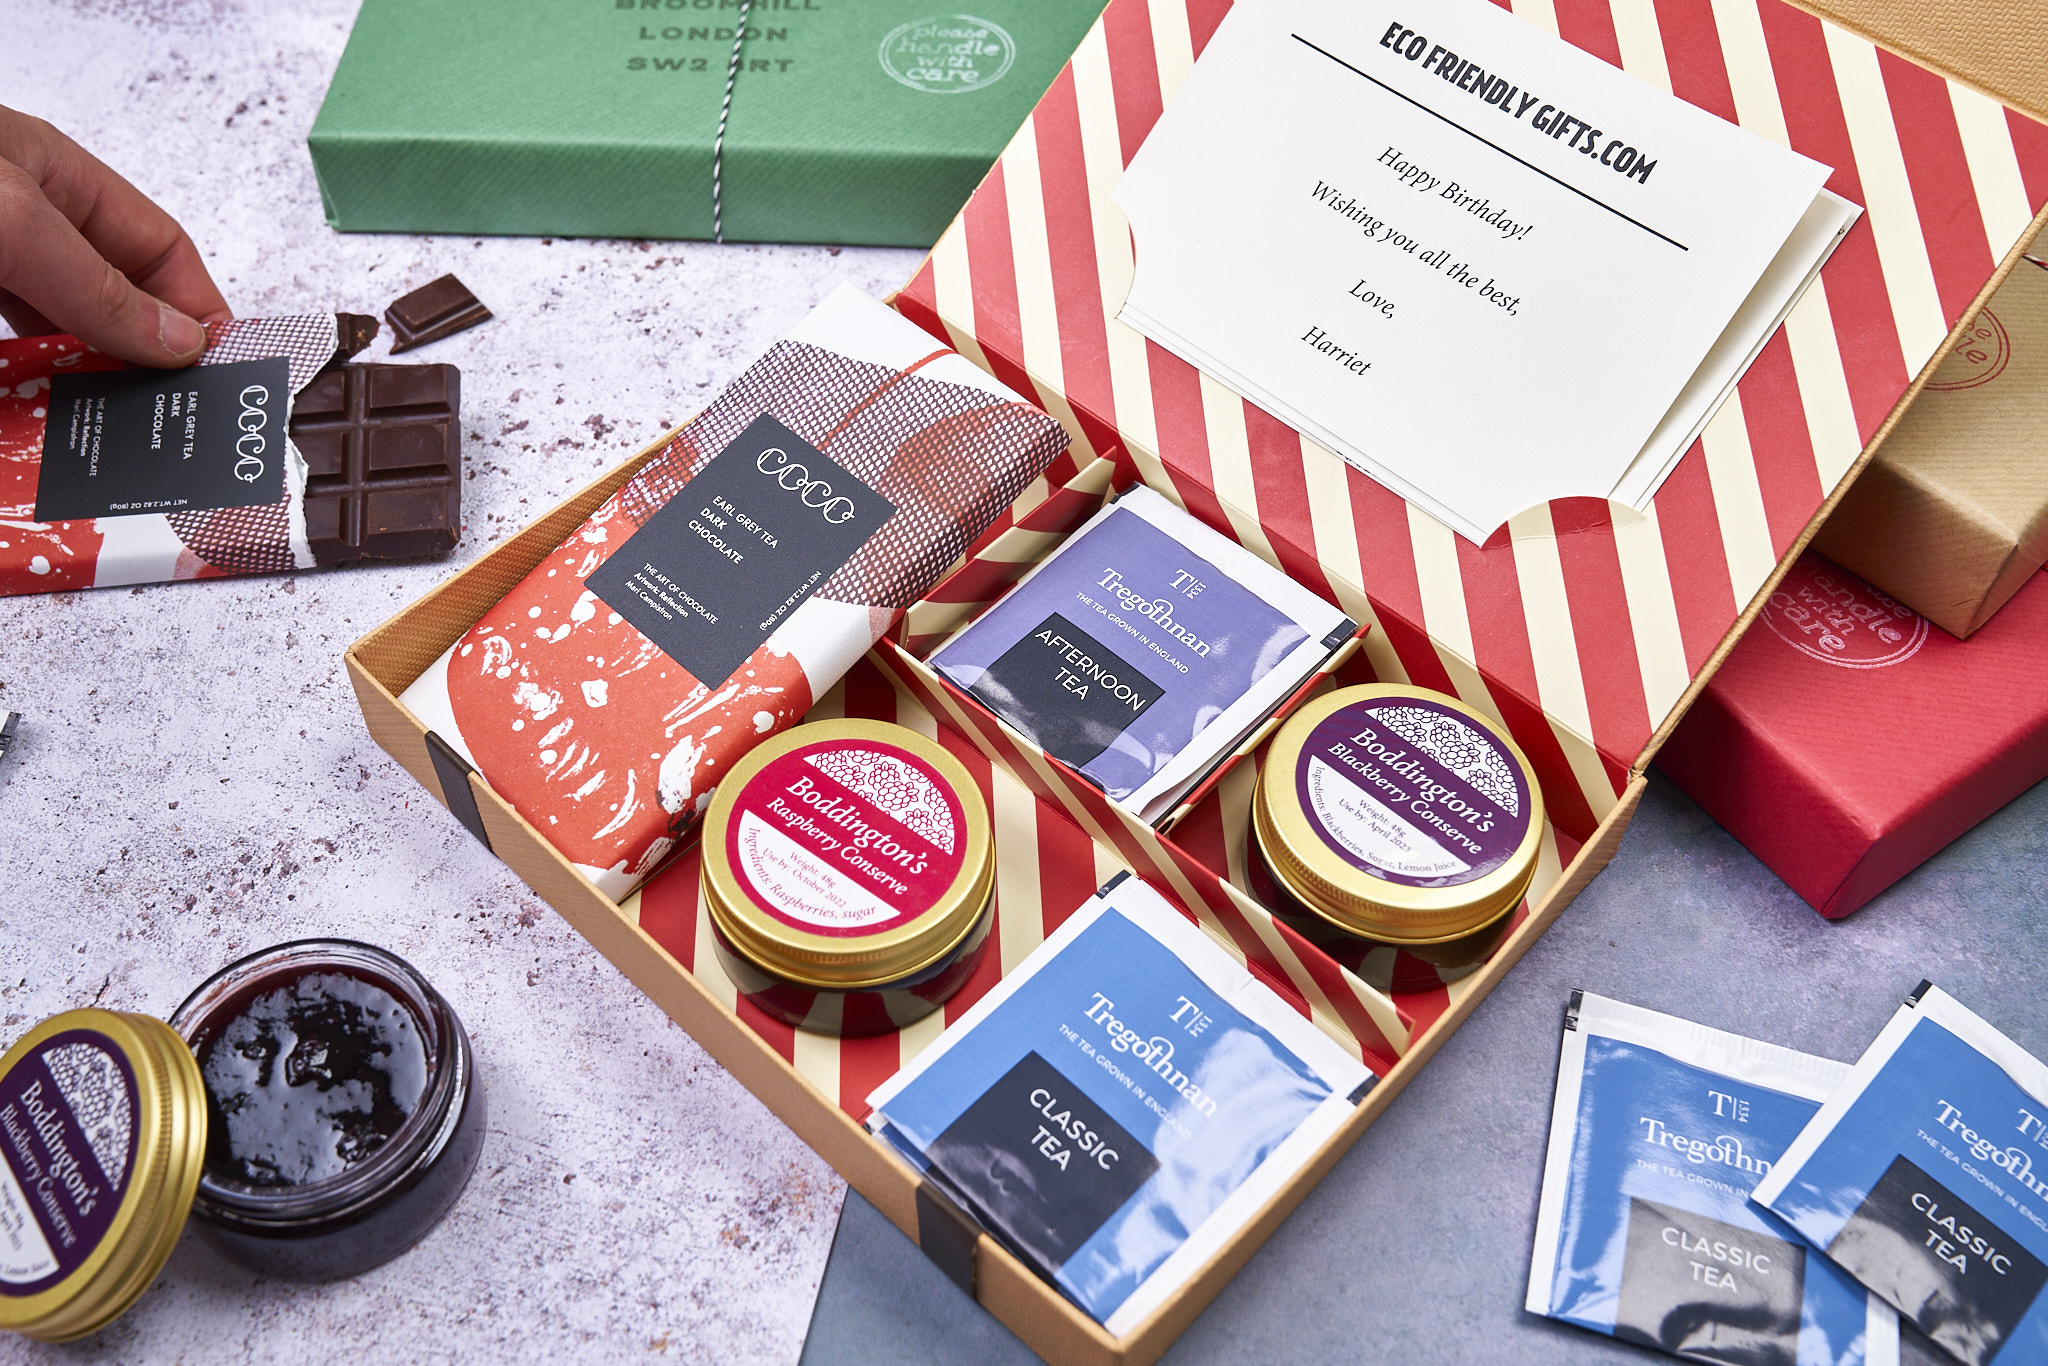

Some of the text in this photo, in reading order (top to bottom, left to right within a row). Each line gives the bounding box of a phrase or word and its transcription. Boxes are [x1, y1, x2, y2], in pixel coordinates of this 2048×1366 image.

[615, 0, 821, 10] BROOMHILL
[639, 27, 788, 41] LONDON
[896, 36, 999, 56] handle
[913, 24, 988, 39] please
[627, 58, 707, 72] SW2
[906, 68, 979, 83] care
[918, 55, 973, 68] with
[1380, 22, 1657, 184] ECO FRIENDLY GIFTS.COM
[1377, 147, 1533, 241] Happy Birthday!
[1311, 181, 1519, 316] Wishing you all the best,
[1349, 280, 1394, 319] Love,
[1302, 326, 1372, 376] Harriet
[151, 394, 165, 449] CHOCOLATE
[171, 393, 181, 417] DARK
[183, 391, 198, 459] EARL GREY TEA
[81, 425, 90, 456] Reflection
[89, 398, 105, 477] THE ART OF CHOCOLATE
[688, 520, 743, 565] CHOCOLATE
[700, 508, 728, 530] DARK
[712, 496, 778, 548] EARL GREY TEA
[643, 563, 718, 624] THE ART OF CHOCOLATE
[808, 571, 821, 584] NET
[640, 592, 672, 620] Campistron
[659, 592, 689, 617] Reflection
[760, 614, 777, 630] (80g)
[776, 605, 786, 616] OZ
[1097, 568, 1211, 658] Tregothnan
[1770, 592, 1845, 653] care
[1797, 586, 1854, 636] with
[1076, 592, 1188, 674] THE TEA GROWN IN ENGLAND
[1035, 629, 1145, 711] AFTERNOON
[1055, 666, 1090, 701] TEA
[1328, 743, 1482, 855] Blackberry Conserve
[1350, 728, 1494, 833] Boddington's
[786, 776, 927, 874] Boddington's
[1312, 767, 1325, 812] Ingredients:
[1398, 862, 1431, 872] Lemon
[1434, 862, 1456, 872] Juice
[1339, 799, 1411, 852] Use by: April 2023
[1359, 800, 1406, 838] Weight: 48g
[766, 797, 908, 895] Raspberry Conserve
[790, 852, 836, 888] Weight: 48g
[744, 827, 876, 921] Ingredients: Raspberries, sugar
[763, 848, 846, 908] Use by: October 2022
[1058, 1024, 1191, 1139] THE TEA GROWN IN ENGLAND
[1084, 992, 1217, 1119] Tregothnan
[20, 1079, 99, 1217] Boddington's
[1030, 1088, 1119, 1171] CLASSIC
[1031, 1126, 1071, 1172] TEA
[1640, 1117, 1773, 1175] Tregothn
[1934, 1099, 2048, 1203] Tregothn
[0, 1103, 43, 1182] Blackberry
[37, 1176, 77, 1248] Conserve
[1635, 1159, 1749, 1197] THE TEA GROWN IN
[1916, 1128, 2048, 1235] THE TEA GROWN IN ENGL
[1661, 1227, 1771, 1275] CLASSIC
[1911, 1192, 2012, 1275] CLASSIC
[1925, 1228, 1967, 1275] TEA
[1688, 1262, 1738, 1294] TEA
